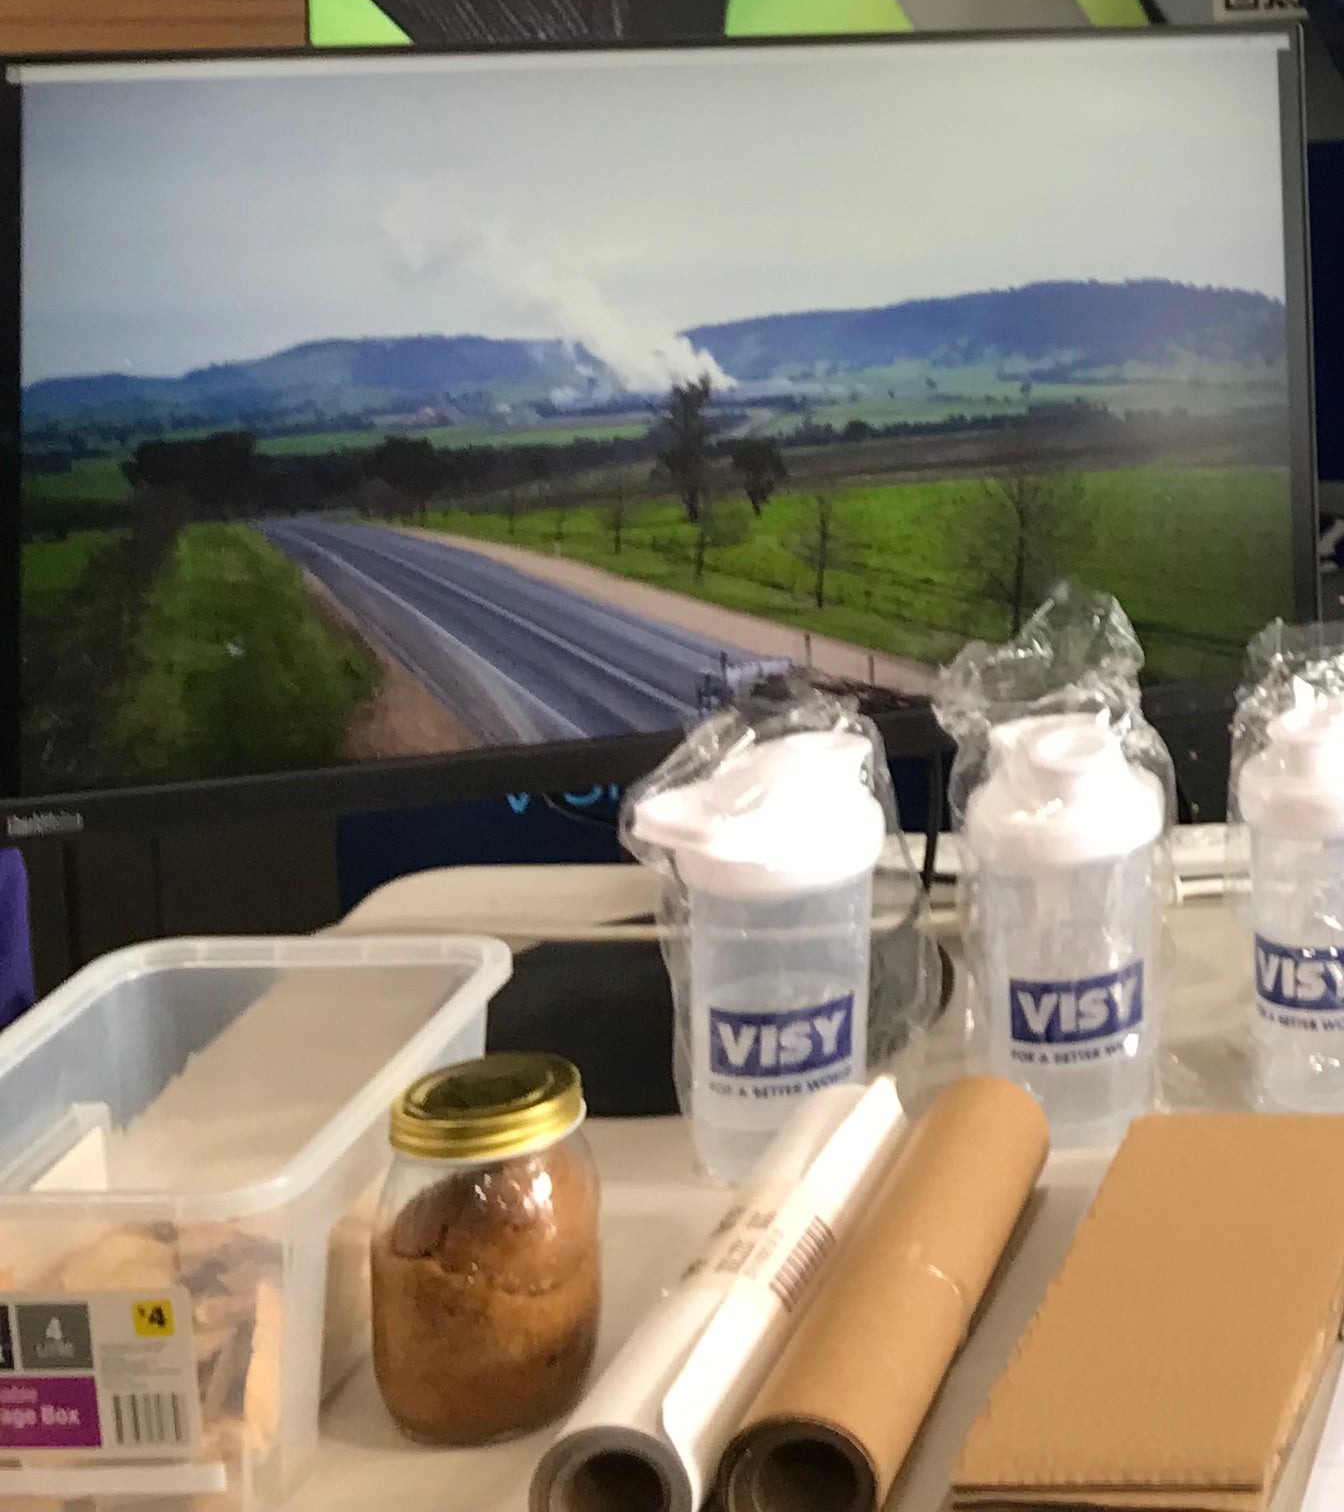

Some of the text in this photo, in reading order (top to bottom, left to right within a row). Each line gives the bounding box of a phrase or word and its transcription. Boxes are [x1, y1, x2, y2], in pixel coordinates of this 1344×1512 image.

[1017, 976, 1138, 1035] VISY
[716, 1009, 848, 1068] VISY
[40, 1403, 81, 1426] Box
